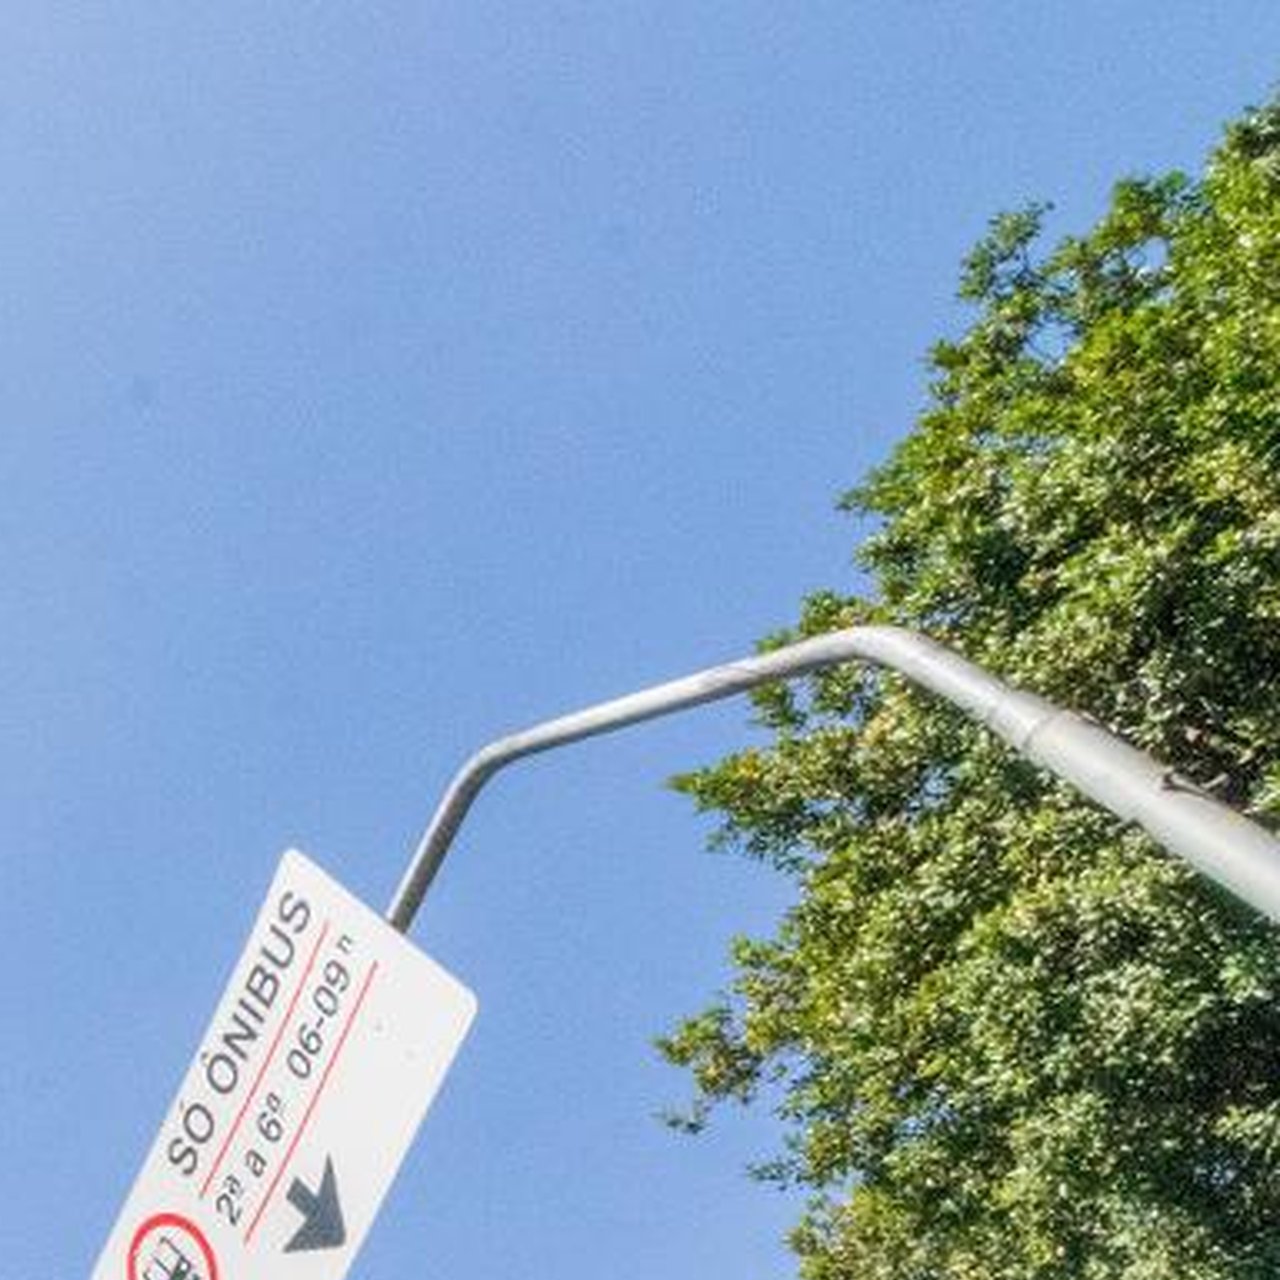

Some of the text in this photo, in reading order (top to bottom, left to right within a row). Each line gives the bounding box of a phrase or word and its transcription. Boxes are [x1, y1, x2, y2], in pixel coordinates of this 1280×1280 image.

[168, 891, 312, 1176] SÓ ÔNIBUS
[246, 1149, 268, 1178] a
